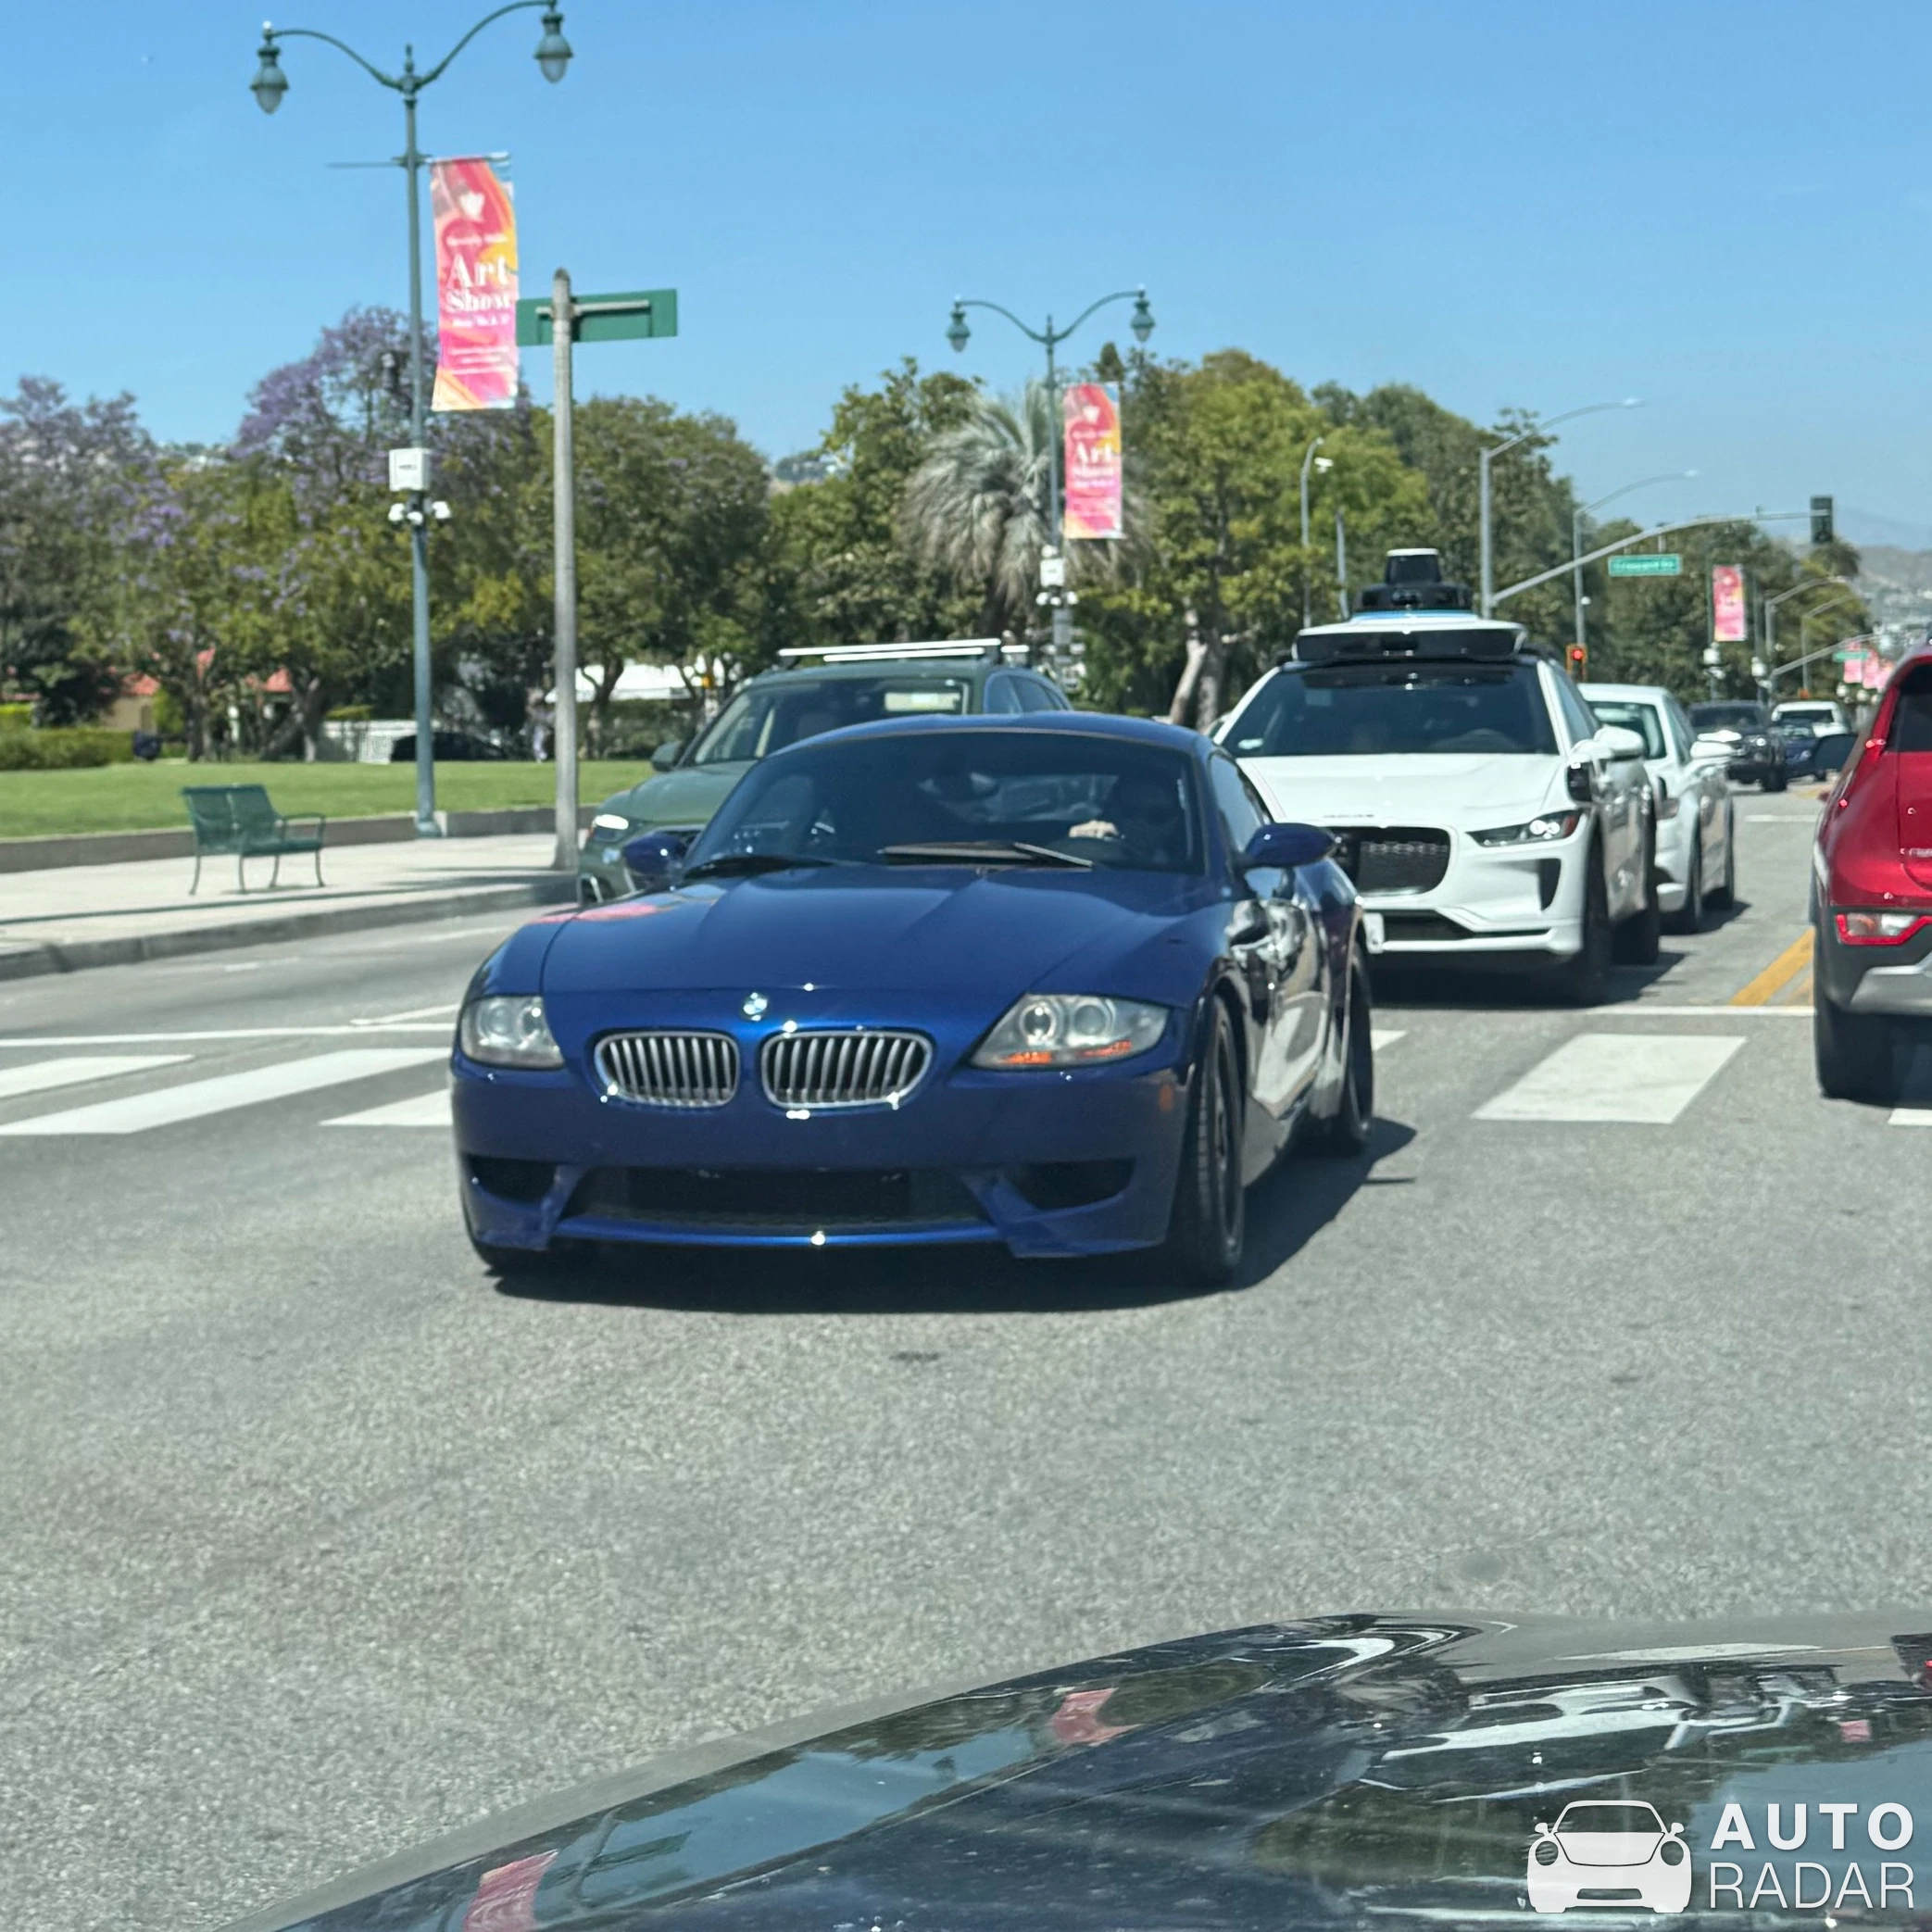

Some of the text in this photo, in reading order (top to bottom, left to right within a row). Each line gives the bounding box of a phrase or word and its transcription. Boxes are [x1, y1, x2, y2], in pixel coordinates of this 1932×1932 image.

[445, 253, 509, 288] Art
[445, 288, 511, 313] Show
[1073, 440, 1114, 463] Art
